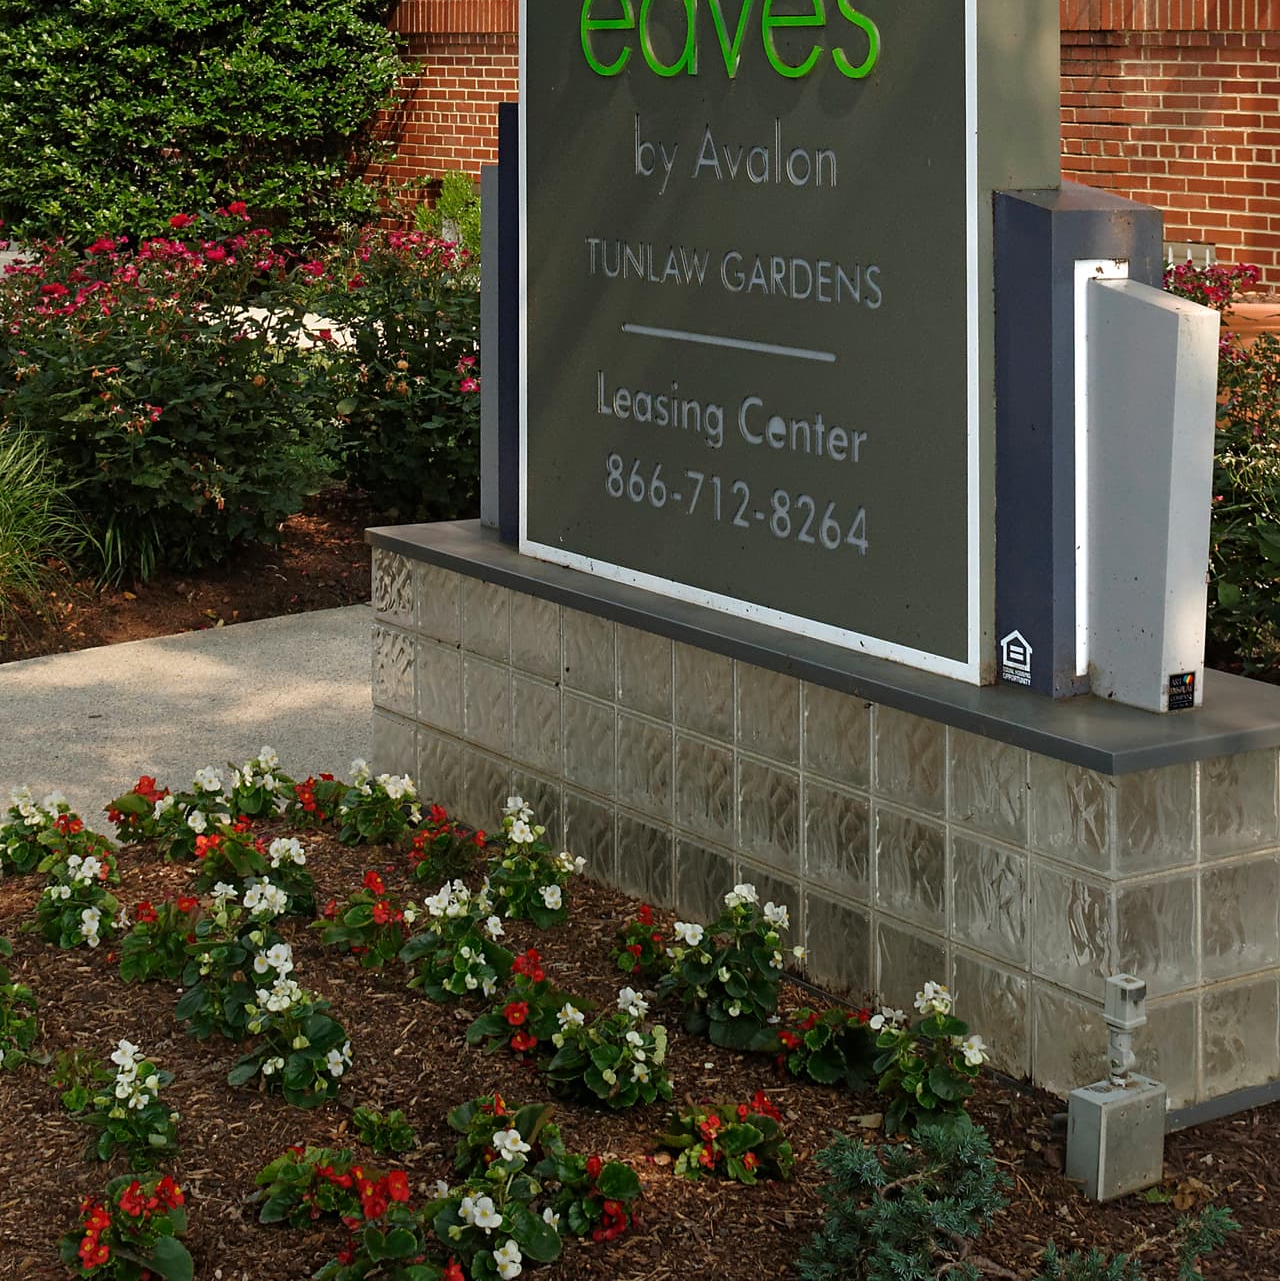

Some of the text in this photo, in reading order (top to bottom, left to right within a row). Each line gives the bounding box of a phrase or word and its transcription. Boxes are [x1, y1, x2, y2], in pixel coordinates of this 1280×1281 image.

[635, 112, 837, 195] by Avalon
[585, 237, 883, 309] TUNLAW GARDENS
[597, 369, 868, 463] Leasing Center
[606, 452, 869, 557] 866-712-8264
